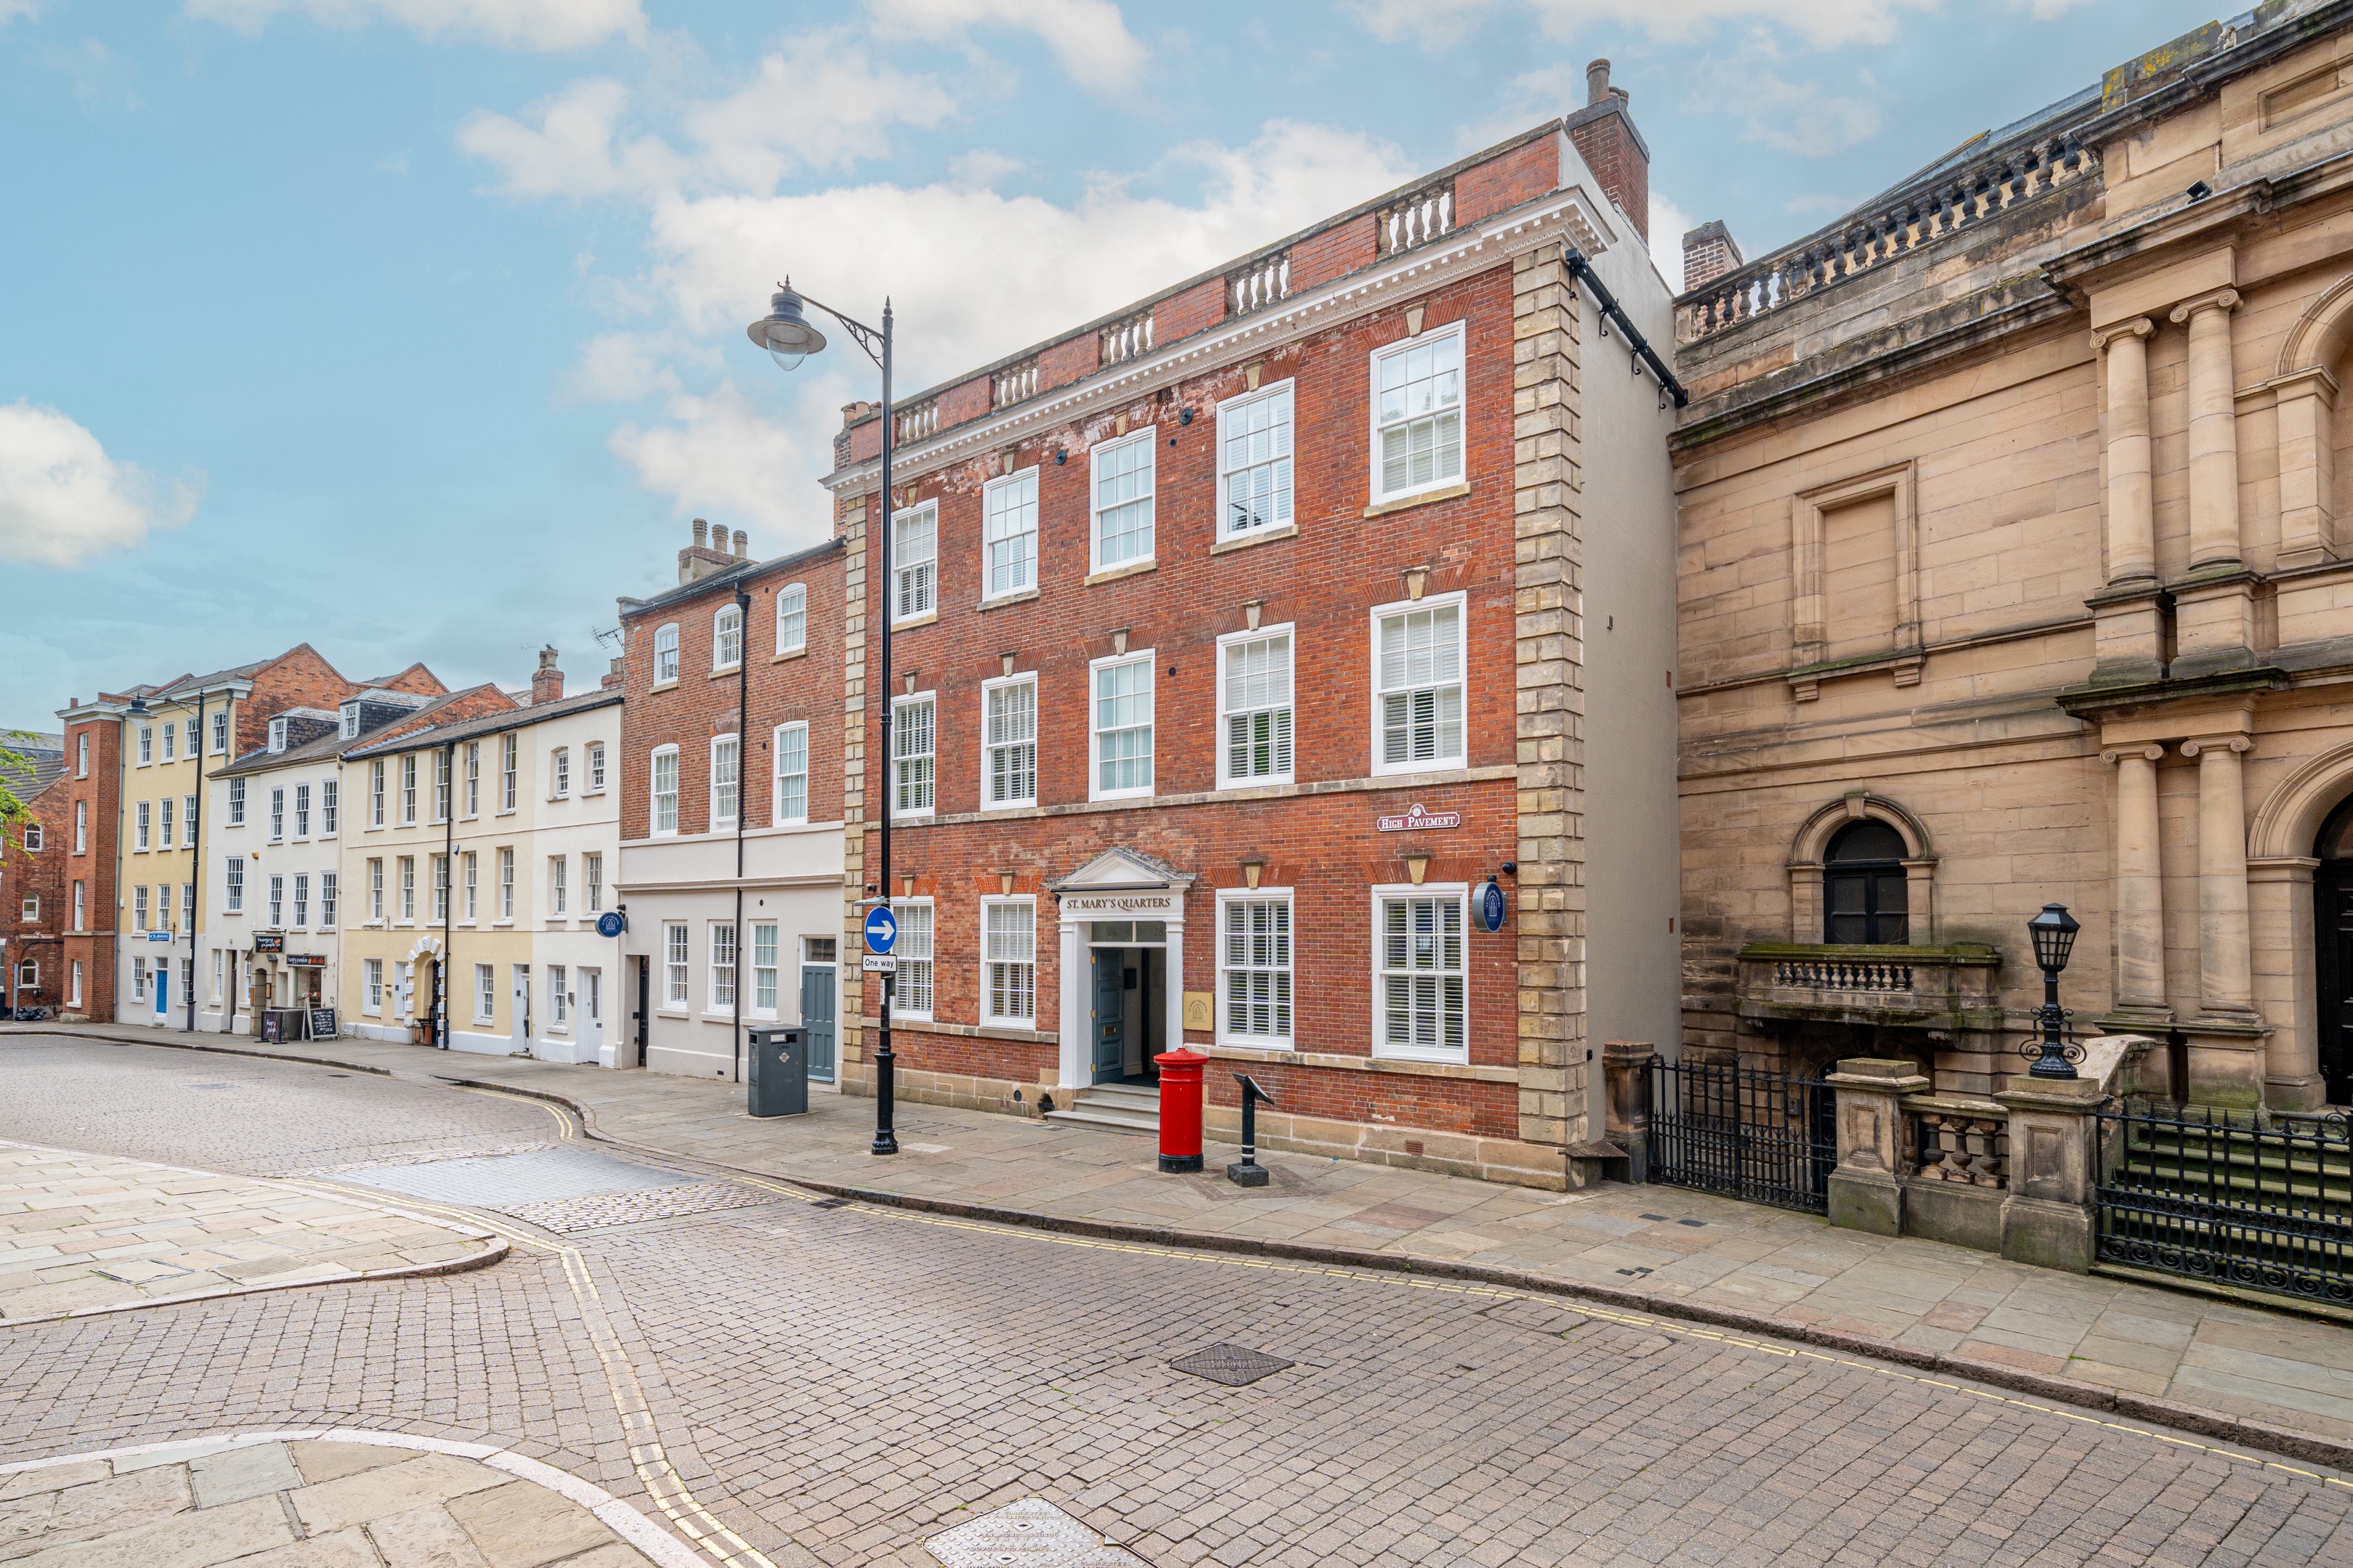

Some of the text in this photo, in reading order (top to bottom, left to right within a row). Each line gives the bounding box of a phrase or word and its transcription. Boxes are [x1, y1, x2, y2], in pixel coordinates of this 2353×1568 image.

[1382, 816, 1455, 829] HIGH PAVEMENT
[1067, 897, 1170, 911] ST. MARY'S QUARTERS
[1107, 927, 1117, 936] 26
